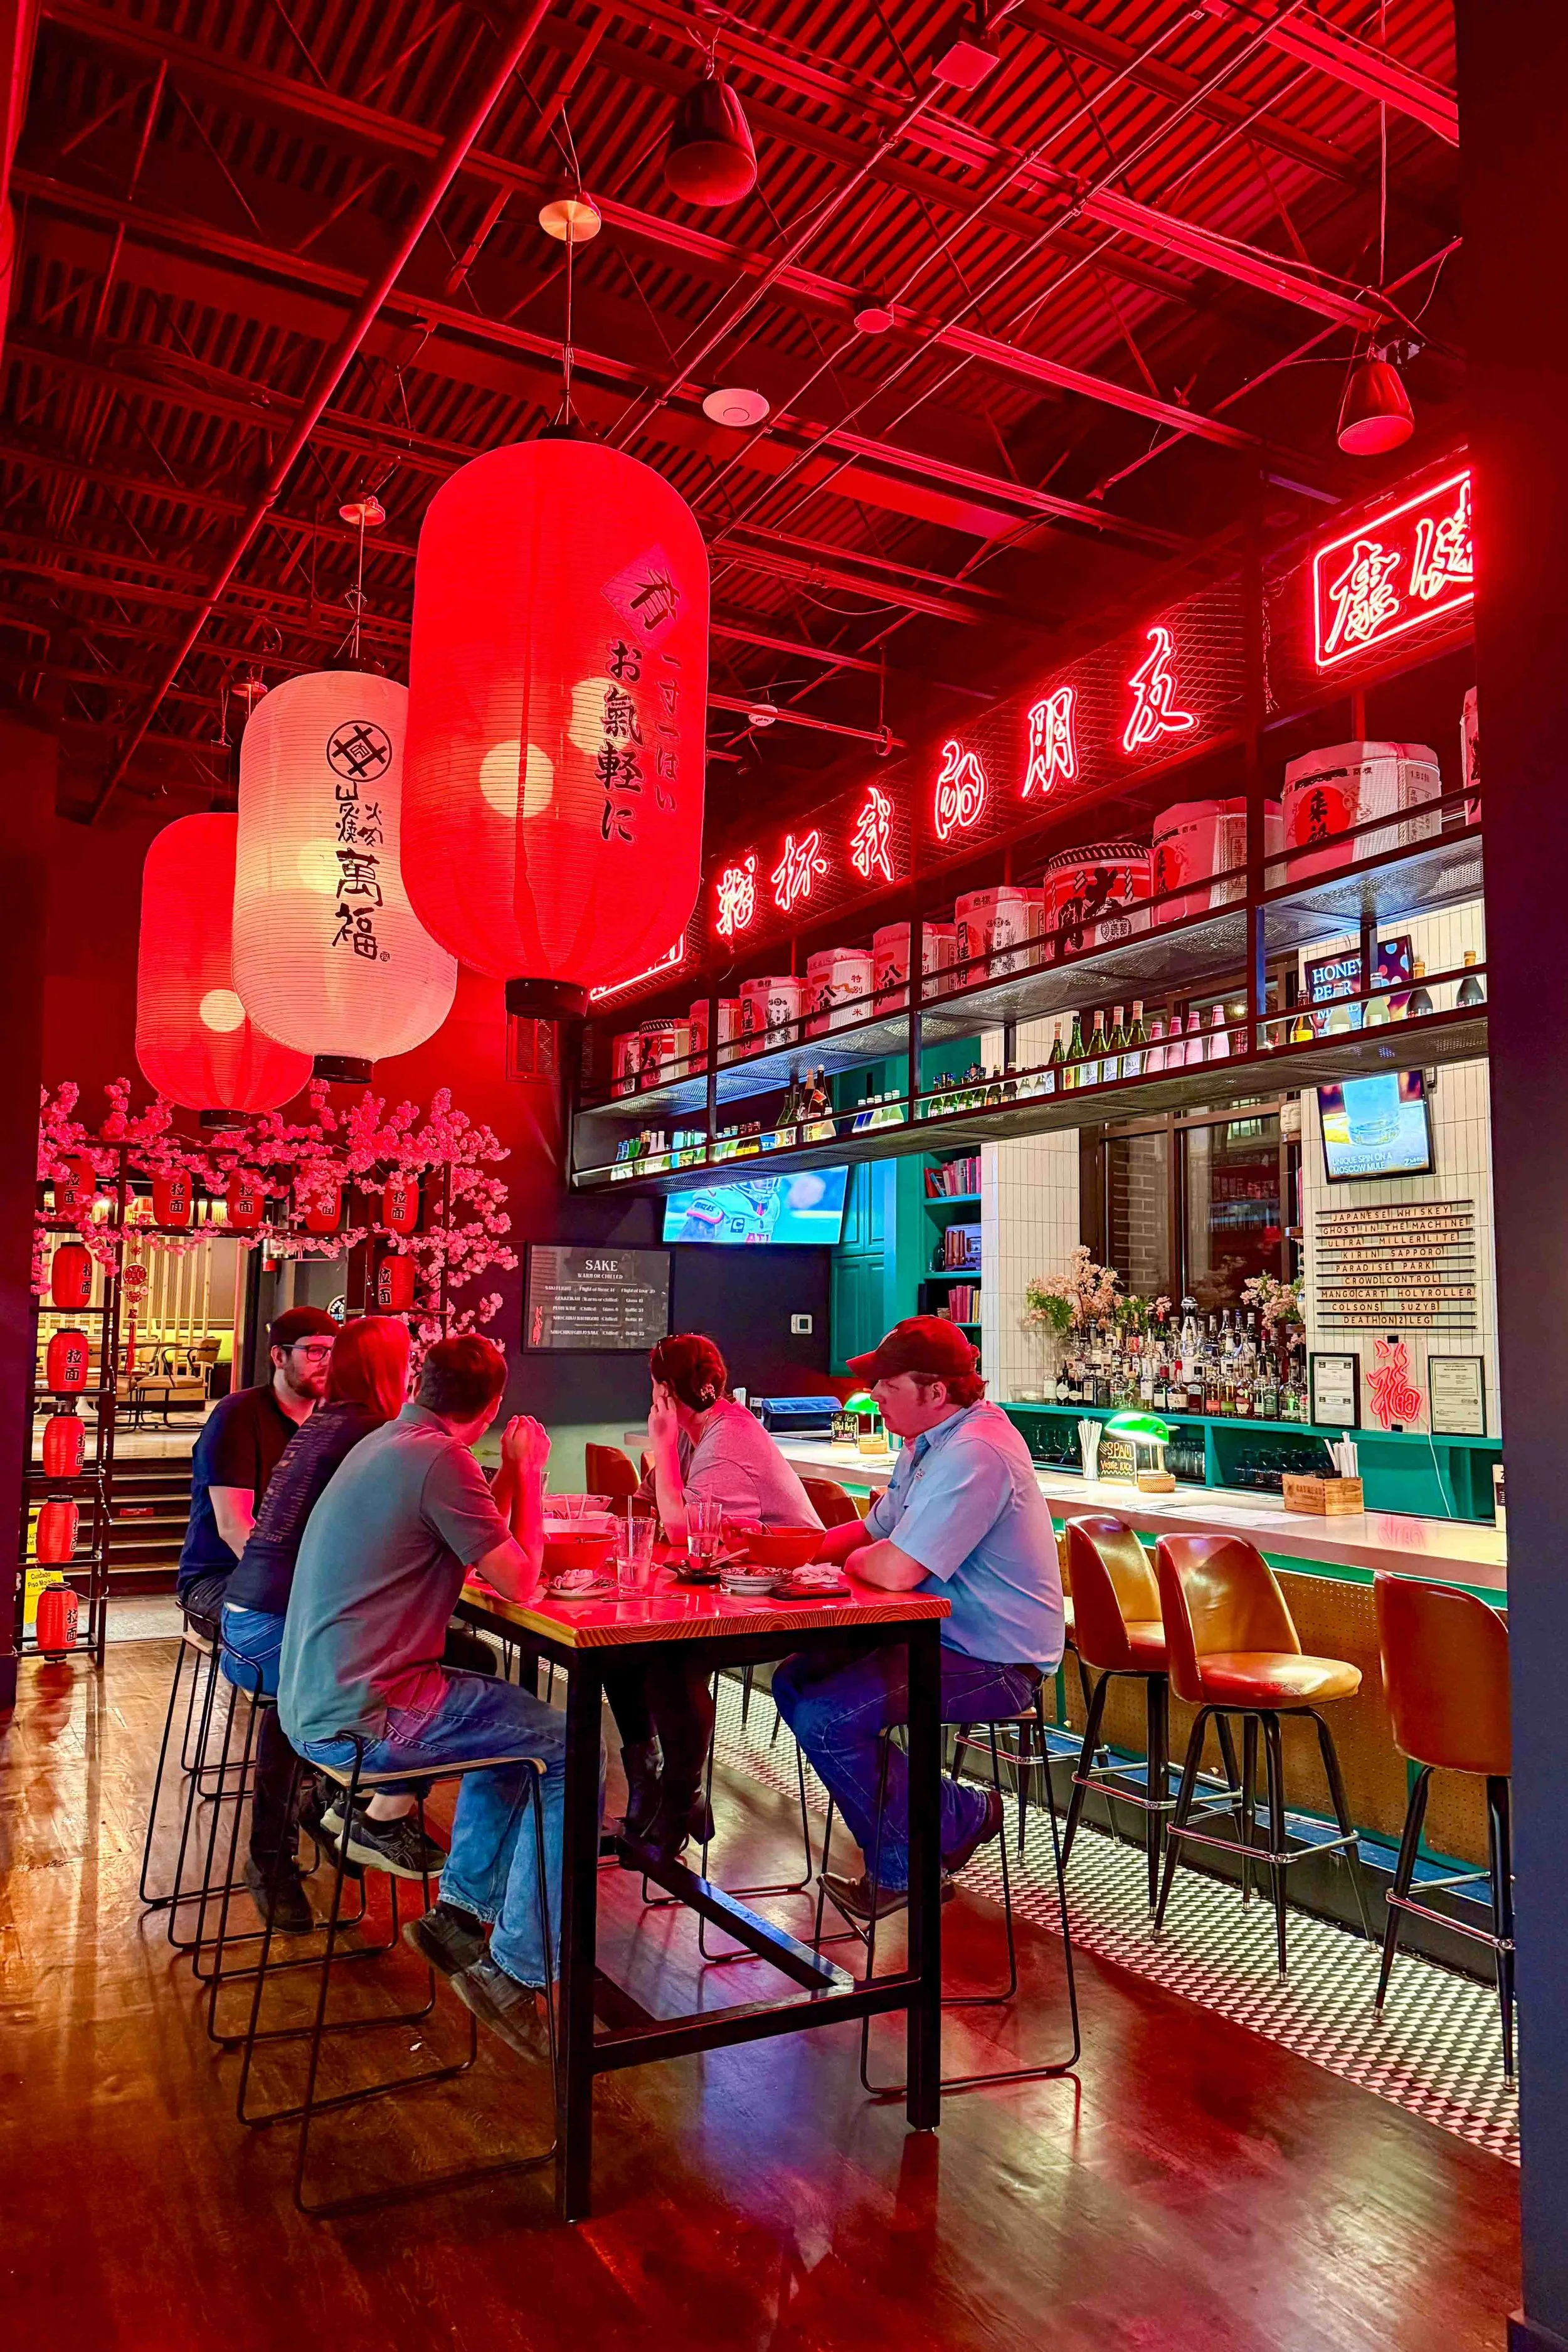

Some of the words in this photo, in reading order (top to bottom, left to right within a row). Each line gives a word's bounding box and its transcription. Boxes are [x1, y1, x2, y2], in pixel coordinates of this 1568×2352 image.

[851, 975, 862, 1015] 特別米
[1314, 981, 1355, 1003] PER
[1333, 1155, 1357, 1165] UNIQUE
[1358, 1154, 1373, 1163] SPIN
[1333, 1163, 1365, 1174] MOSCOW
[1367, 1162, 1385, 1171] MULE
[171, 1183, 184, 1212] 拉面
[392, 1192, 407, 1220] 拉面
[1333, 1211, 1387, 1222] JAPANESE
[1397, 1206, 1449, 1217] WHISKEY
[1323, 1226, 1355, 1234] GHOST
[1385, 1222, 1405, 1231] THE
[1412, 1219, 1465, 1229] MACHINE
[1328, 1239, 1361, 1248] ULTRA
[1380, 1236, 1422, 1244] MILLER
[1427, 1233, 1455, 1242] LITE
[1343, 1251, 1377, 1259] KIRIN
[1391, 1248, 1441, 1257] SAPPORO
[585, 1259, 618, 1271] SAKE
[1336, 1263, 1390, 1273] PARADISE
[1387, 1274, 1438, 1283] CONTROL
[1358, 1290, 1385, 1298] CART
[1397, 1288, 1471, 1297] HOLYROLLER
[65, 1350, 82, 1381] 拉面
[1107, 1442, 1132, 1457] SPAM
